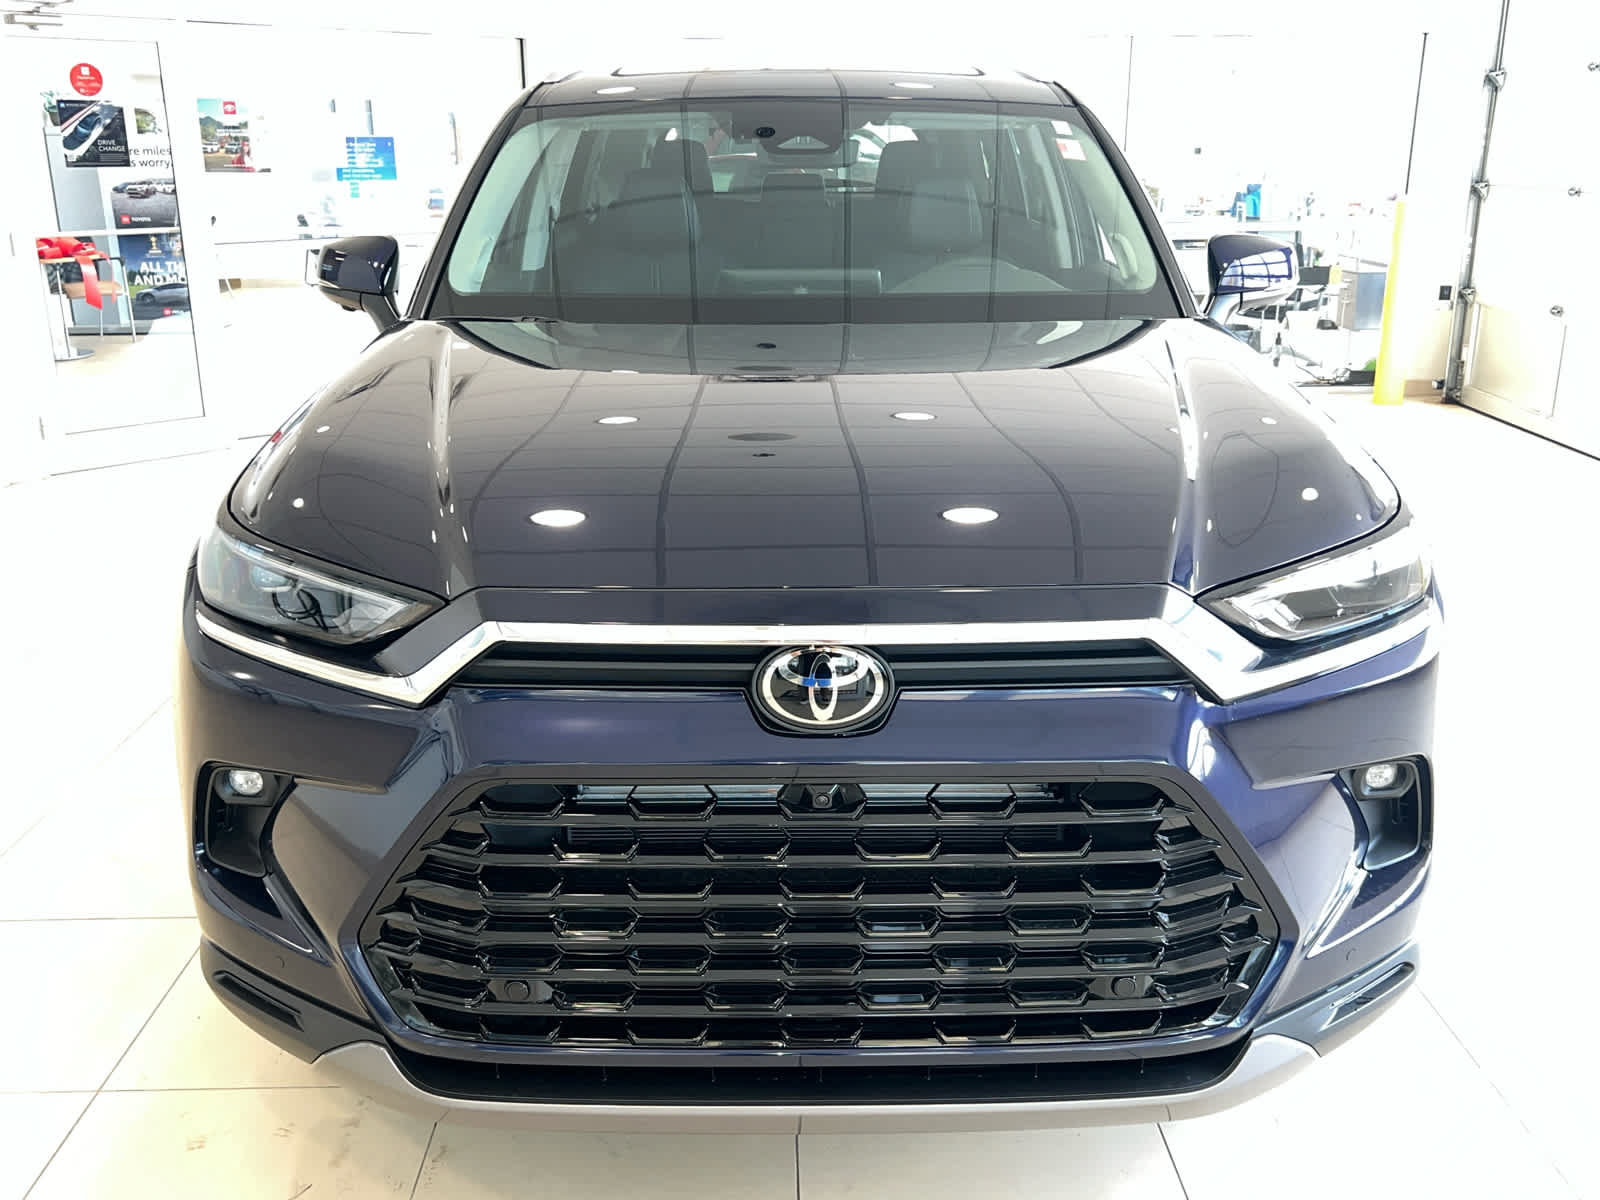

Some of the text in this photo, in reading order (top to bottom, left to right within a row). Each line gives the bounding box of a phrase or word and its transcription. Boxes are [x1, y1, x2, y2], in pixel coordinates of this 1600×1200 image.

[143, 145, 171, 156] miles
[140, 261, 164, 273] ALL
[134, 274, 164, 286] AND
